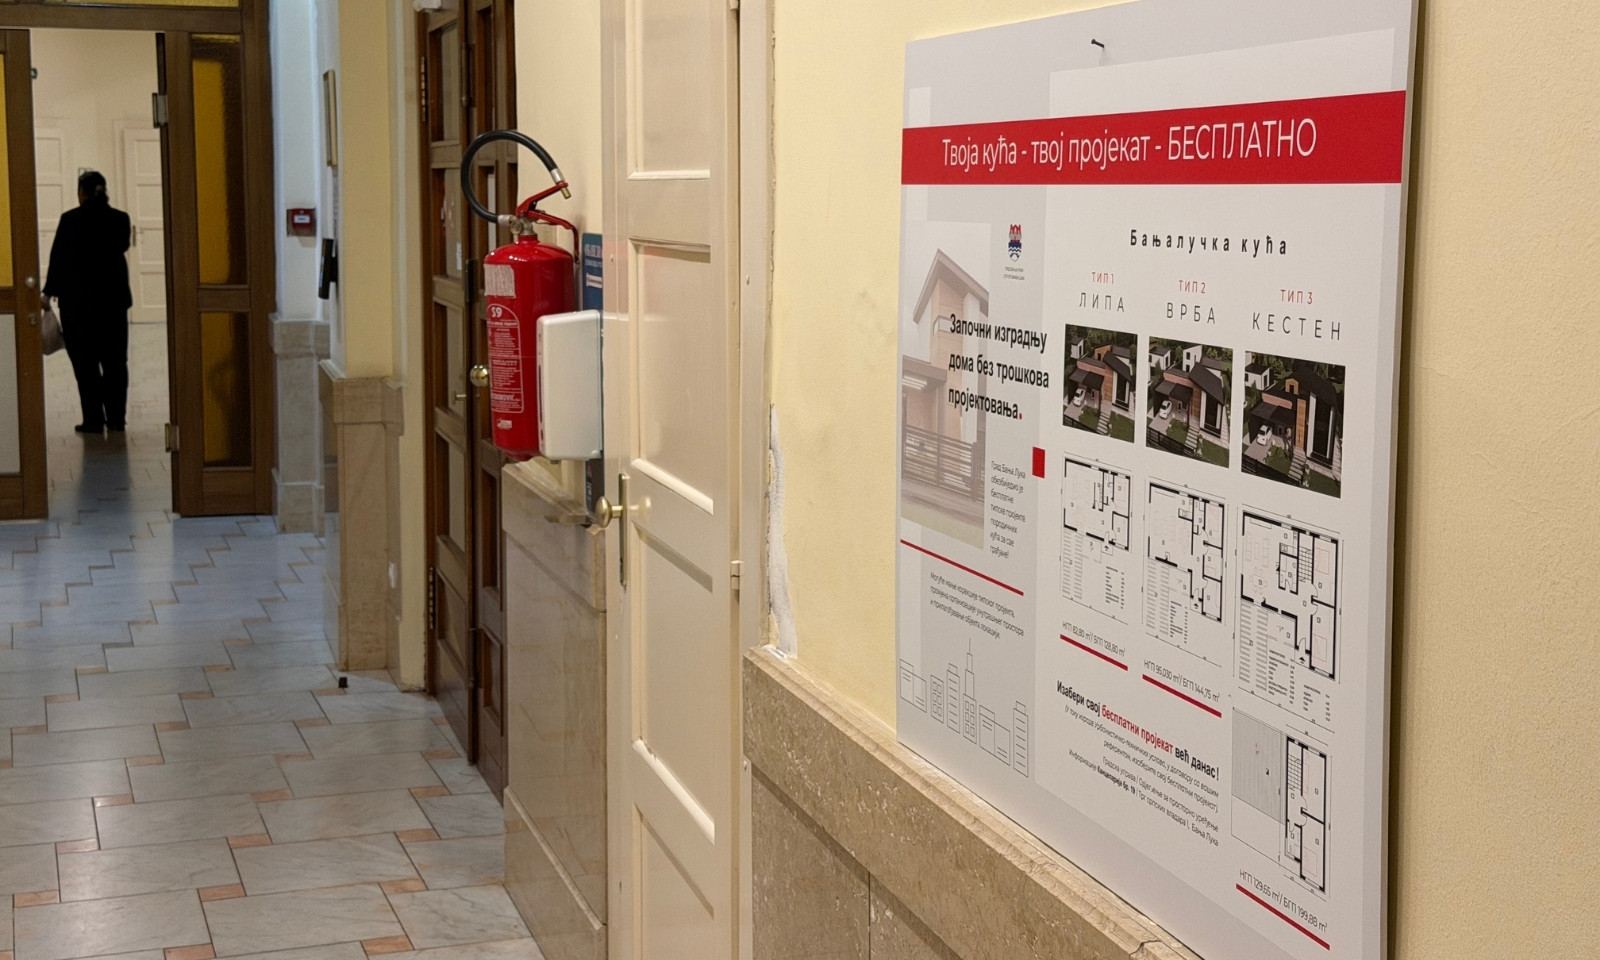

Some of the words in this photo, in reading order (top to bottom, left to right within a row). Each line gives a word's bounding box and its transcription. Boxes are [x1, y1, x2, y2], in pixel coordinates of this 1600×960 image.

[943, 137, 978, 172] Твоја
[983, 135, 1016, 172] кућа
[1031, 132, 1064, 171] твој
[1068, 129, 1150, 170] пројекат
[1168, 118, 1317, 160] БЕСПЛАТНО
[1130, 229, 1230, 254] Бањалучка
[1241, 235, 1286, 258] кућа
[1092, 272, 1108, 284] ТИП
[1110, 274, 1114, 284] 1
[1179, 280, 1198, 292] ТИП
[1201, 282, 1206, 294] 2
[1079, 292, 1124, 312] ЛИПА
[1280, 289, 1304, 304] ТИП
[1307, 292, 1313, 304] 3
[1166, 302, 1216, 324] ВРБА
[1252, 312, 1340, 340] КЕСТЕН
[950, 314, 992, 340] Започни
[994, 326, 1048, 354] изградњу
[948, 354, 974, 372] дома
[977, 354, 994, 376] без
[996, 363, 1049, 388] трошкова
[948, 388, 1022, 420] пројектовања.
[1057, 680, 1084, 706] Изабери
[1086, 698, 1100, 717] свој
[1102, 704, 1140, 736] бесплатни
[1141, 728, 1174, 754] пројекат
[1174, 747, 1189, 764] већ
[1206, 832, 1219, 847] Лука
[1240, 868, 1253, 884] НГП
[1283, 896, 1297, 913] БГП
